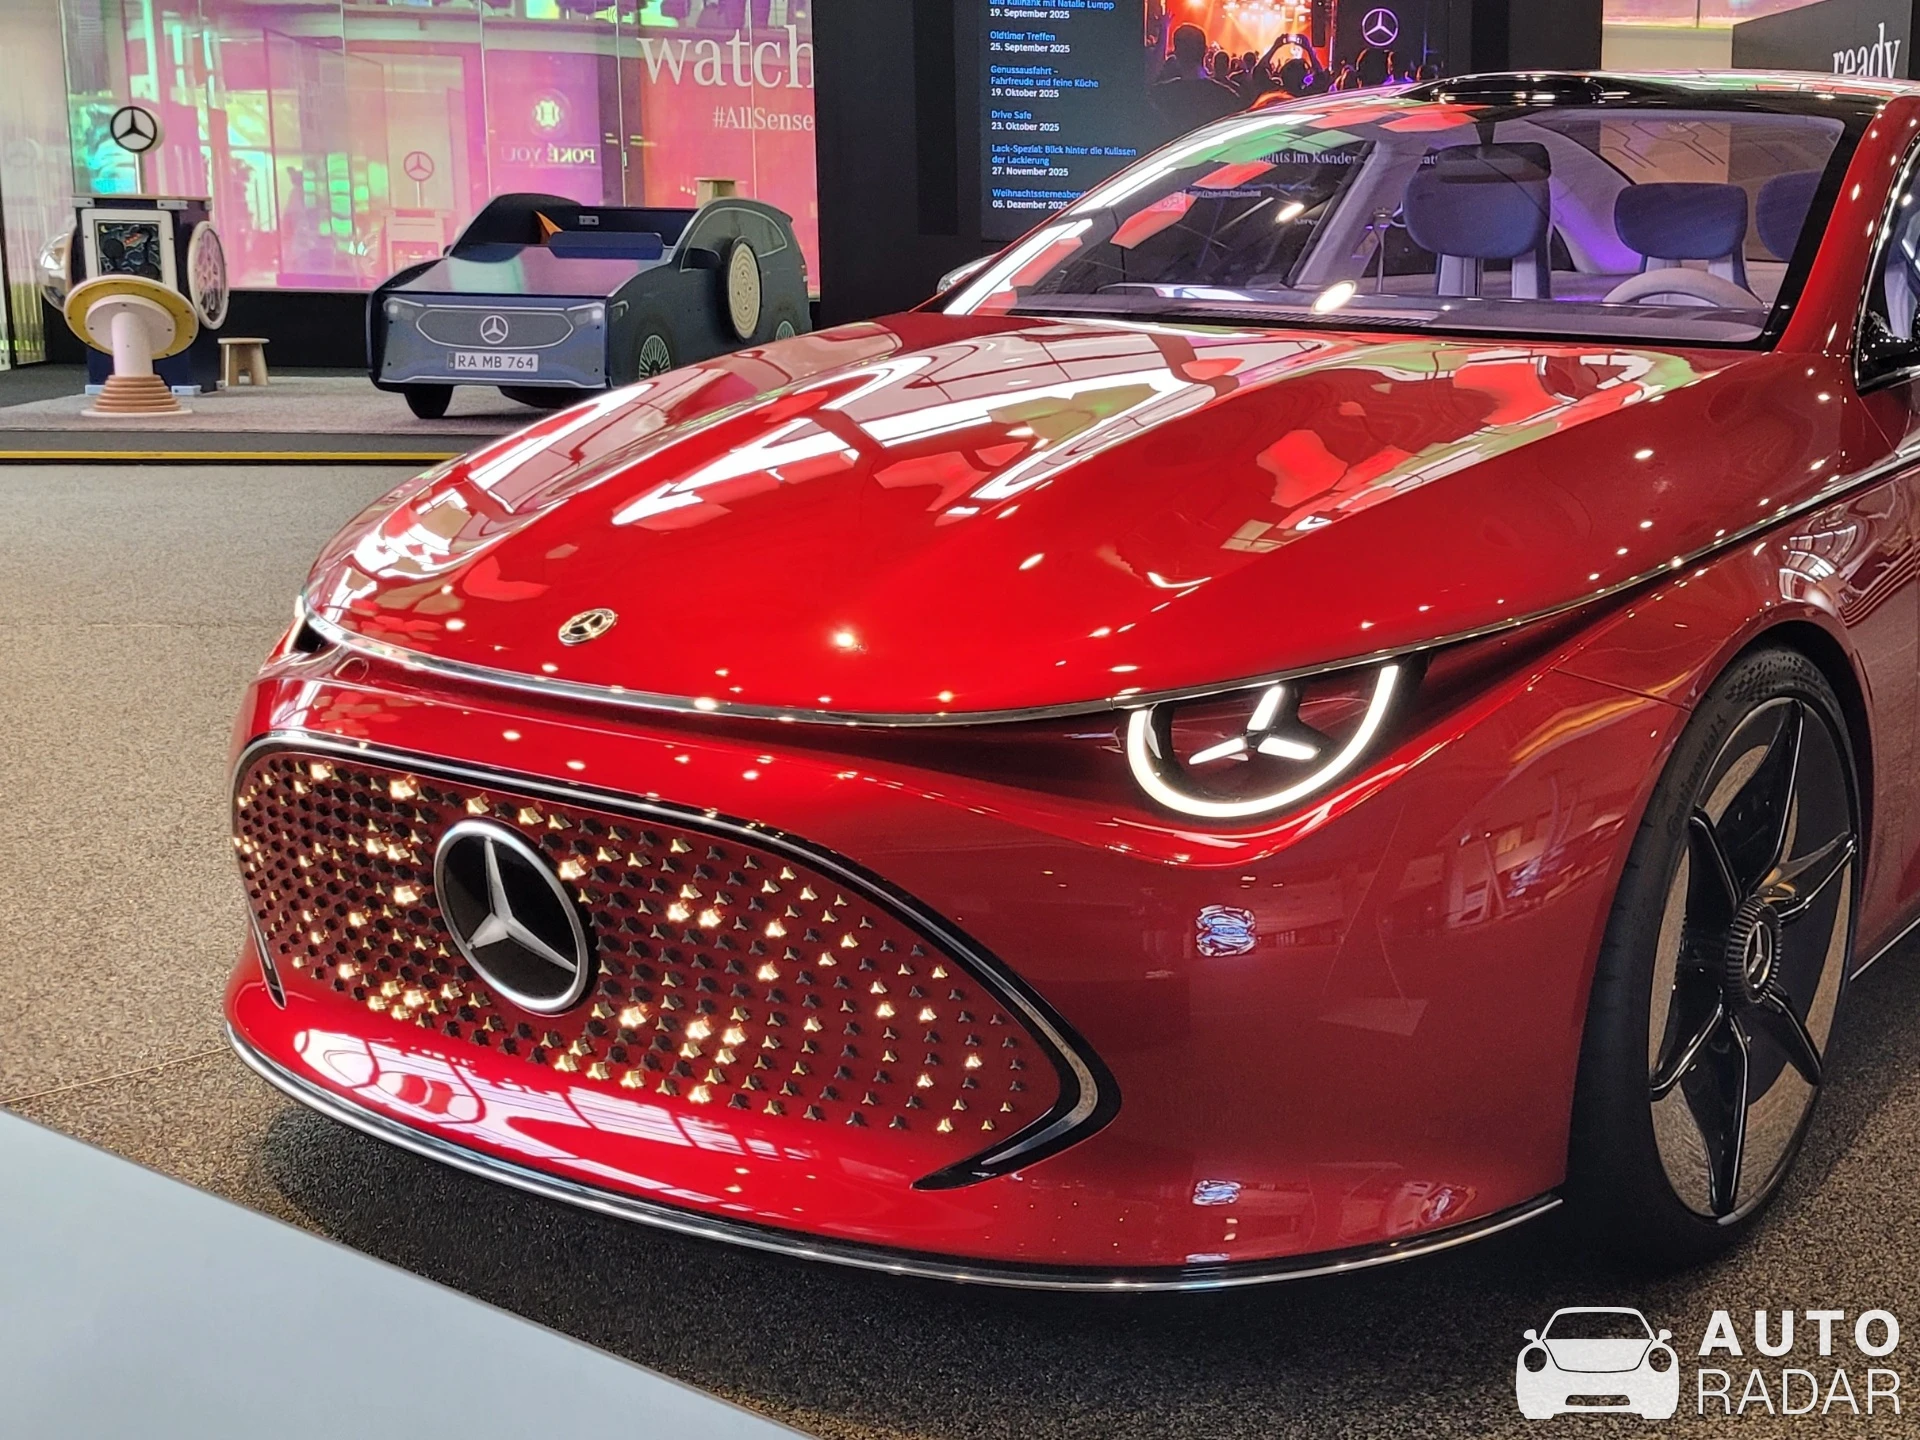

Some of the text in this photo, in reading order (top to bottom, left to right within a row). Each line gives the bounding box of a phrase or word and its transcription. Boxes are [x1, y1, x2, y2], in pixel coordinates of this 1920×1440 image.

[1058, 0, 1085, 8] Natalie
[1087, 1, 1115, 10] Lumpp
[990, 8, 1070, 19] 19. September 2025
[990, 31, 1056, 41] Oldtimer Treffen
[990, 43, 1070, 53] 25. September 2025
[1833, 22, 1901, 79] ready
[636, 24, 814, 89] watch
[990, 65, 1052, 75] Genussausfahrt
[991, 76, 1099, 88] Fahrfreude und feine Küche
[991, 88, 1060, 98] 19. Oktober 2025
[712, 106, 814, 131] #AllSense
[992, 110, 1032, 120] Drive Safe
[992, 122, 1060, 132] 23. Oktober 2025
[992, 144, 1136, 156] Lack-Spezial: Blick hinter die Kulissen
[992, 156, 1050, 166] der Lackierung
[992, 167, 1069, 177] 27. November 2025
[992, 200, 1068, 210] 05. Dezember 2025
[458, 355, 534, 369] RA MB 764
